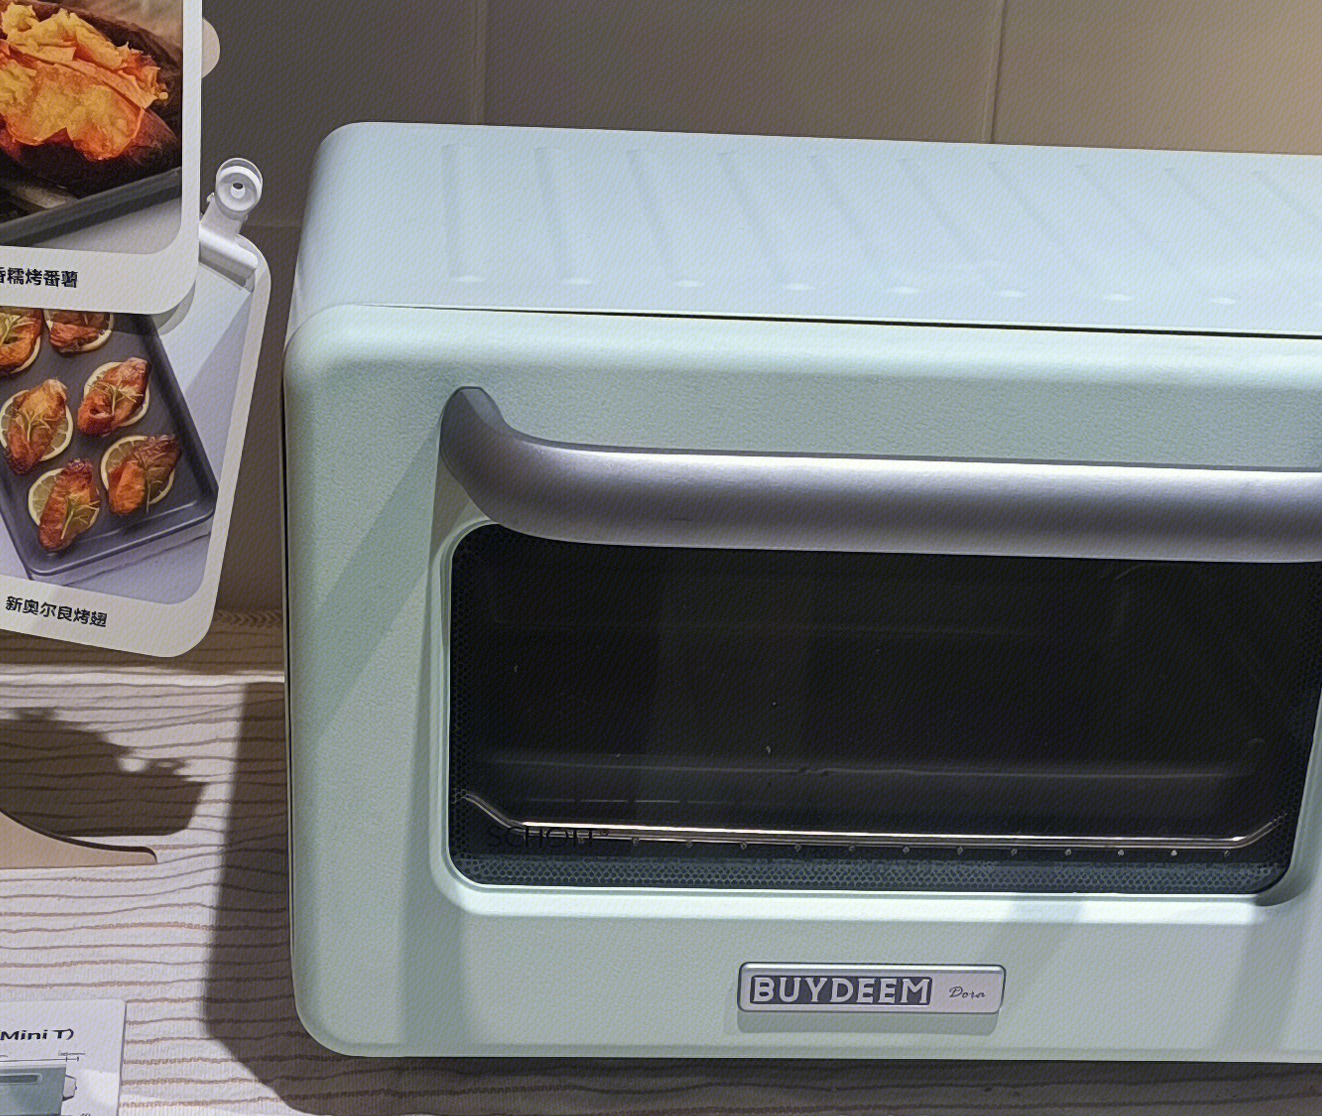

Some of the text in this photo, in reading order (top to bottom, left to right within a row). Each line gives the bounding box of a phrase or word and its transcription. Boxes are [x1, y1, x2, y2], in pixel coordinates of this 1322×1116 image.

[5, 595, 108, 628] 新奥尔良烤翅
[751, 976, 931, 1005] BUYDEEM
